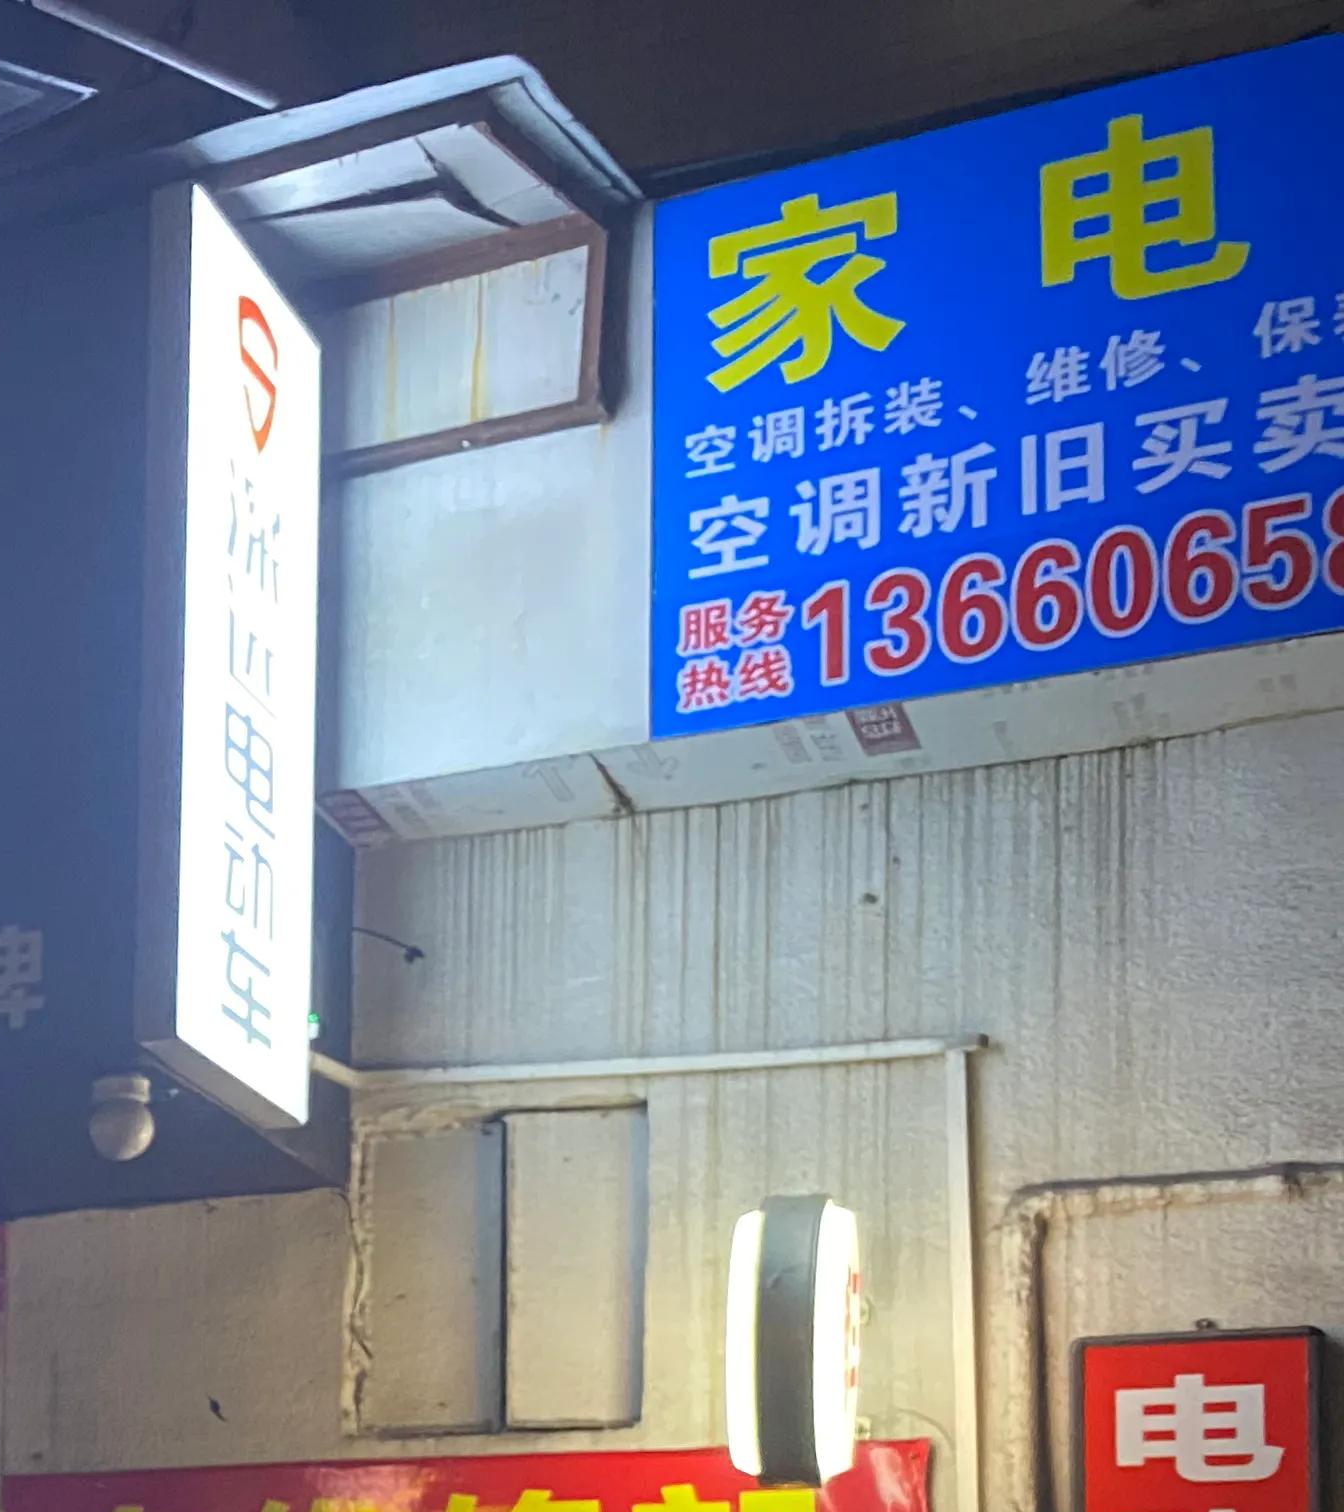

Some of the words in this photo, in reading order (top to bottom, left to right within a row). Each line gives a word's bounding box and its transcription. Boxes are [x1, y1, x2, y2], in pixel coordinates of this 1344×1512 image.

[684, 293, 1344, 479] 空调拆装、维修、保
[688, 374, 1344, 580] 空调新旧买卖
[678, 588, 795, 656] 服务
[678, 648, 795, 715] 热线
